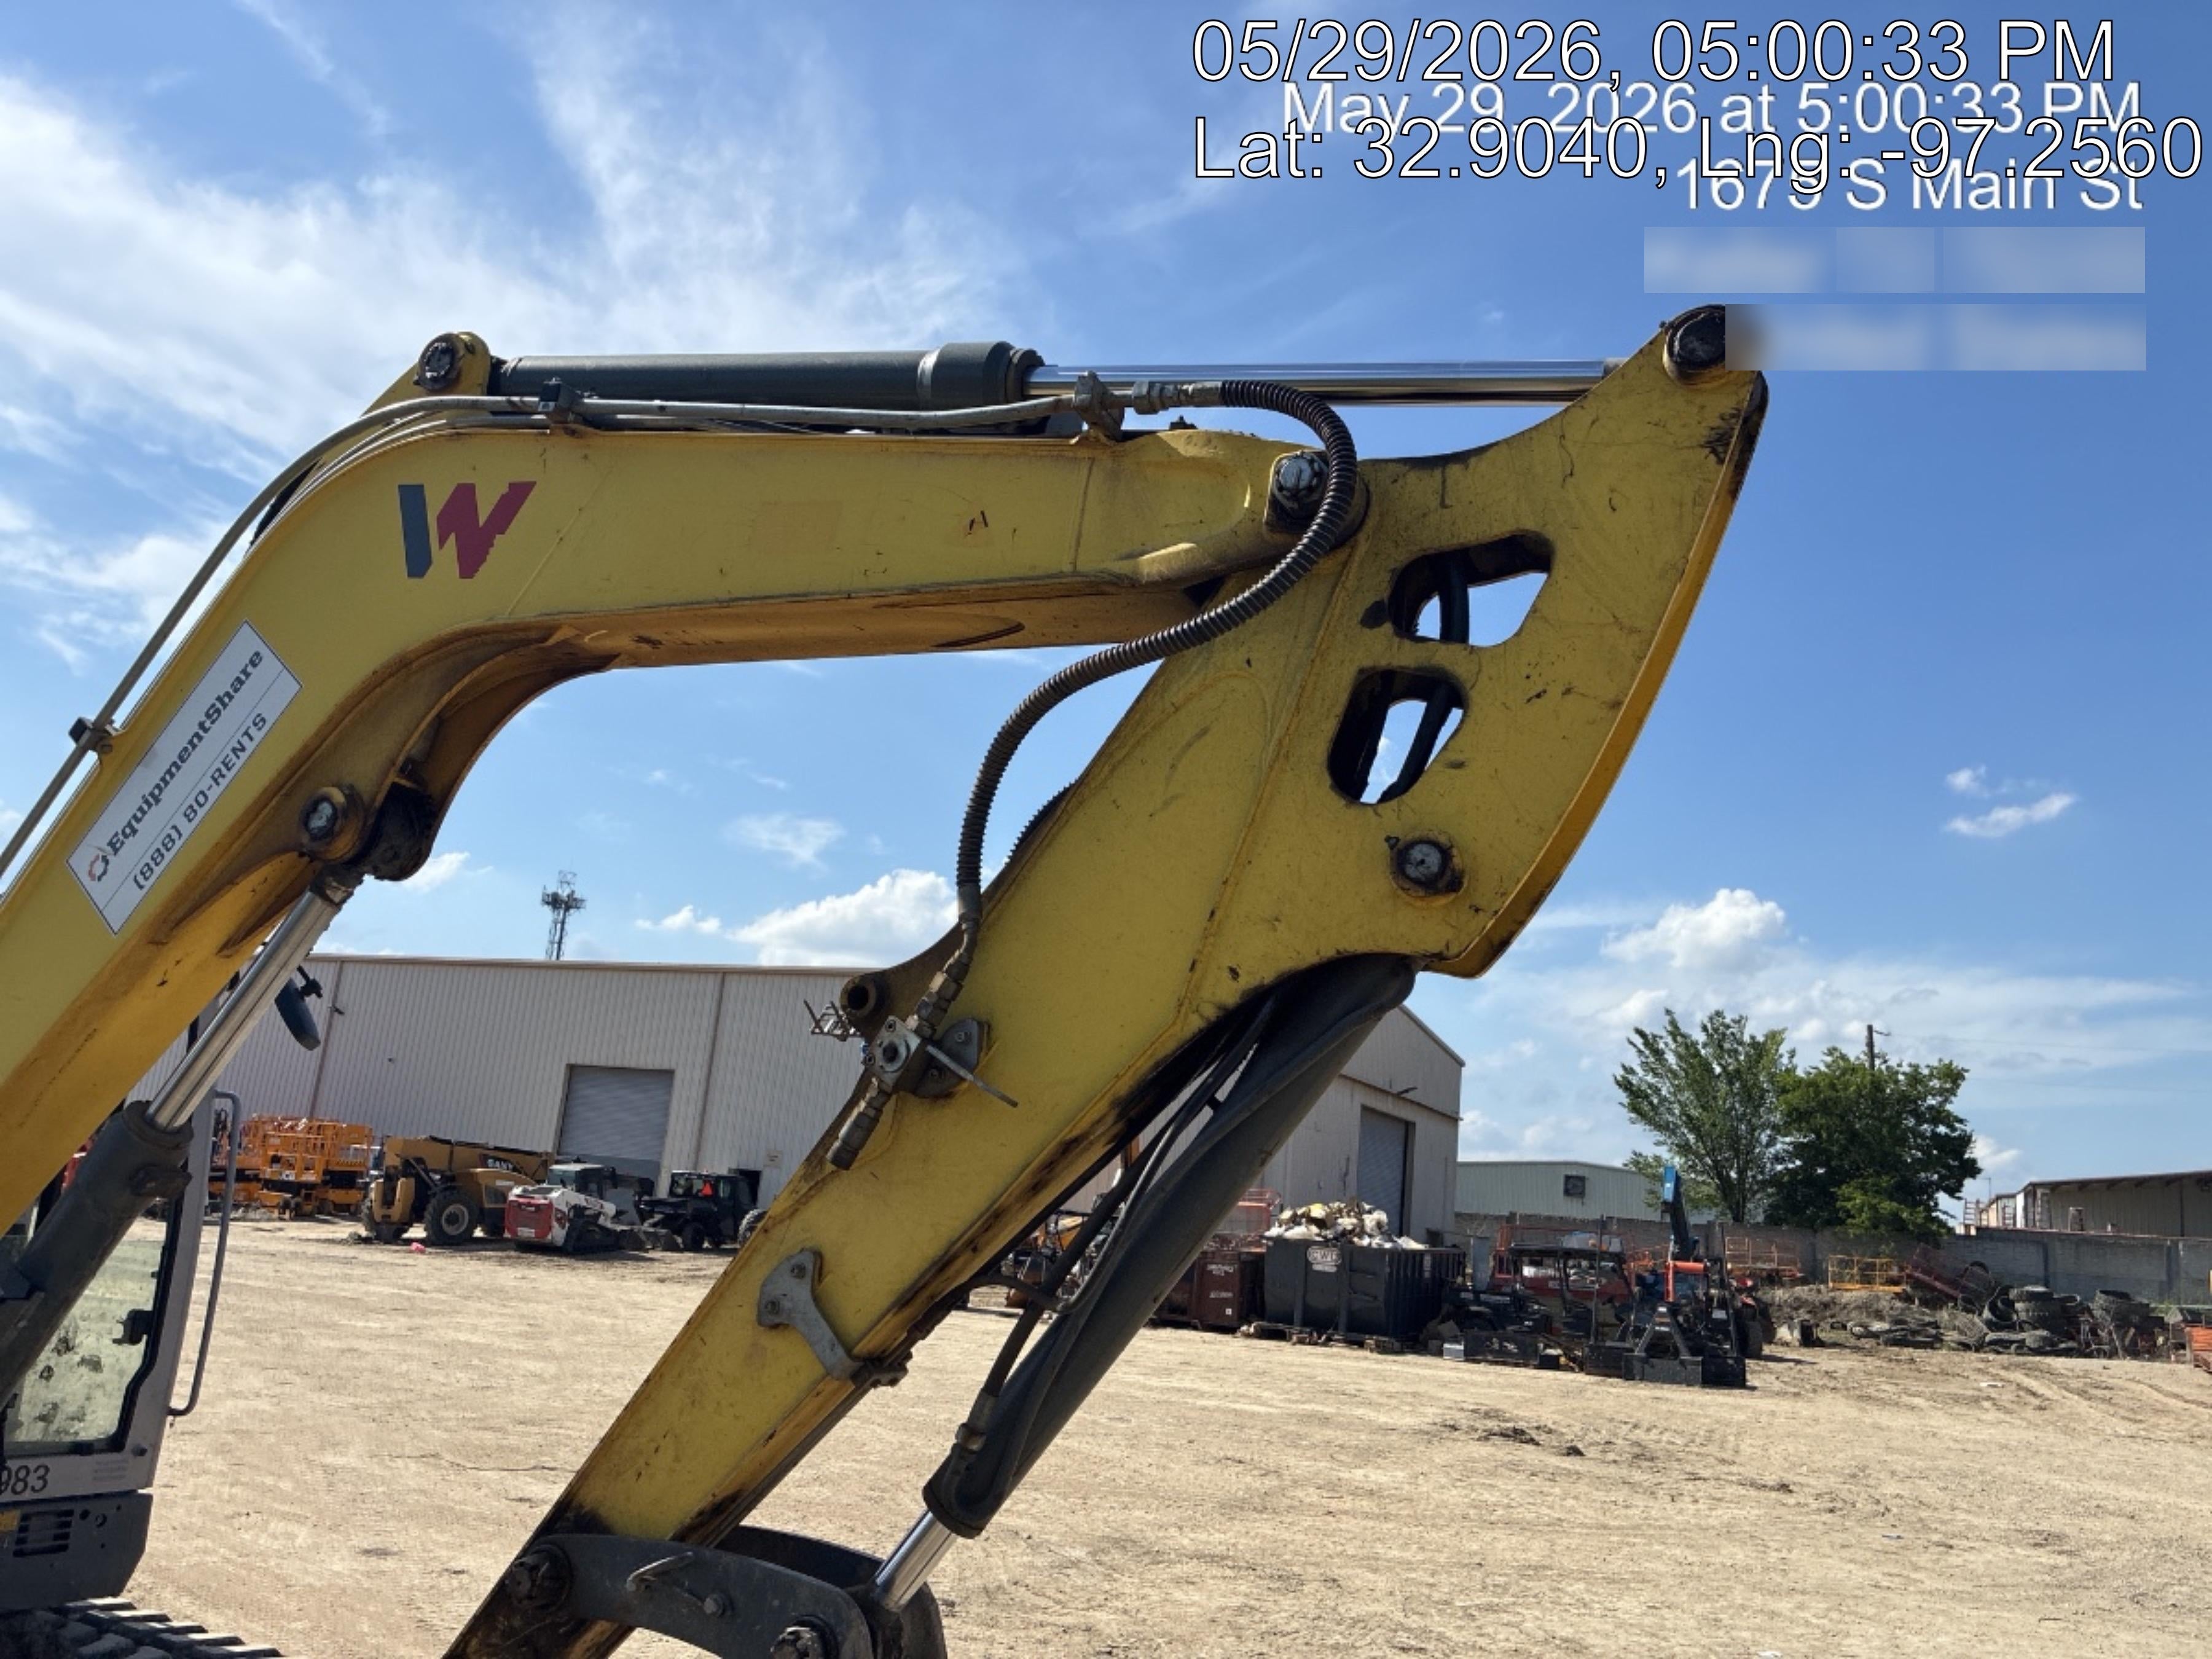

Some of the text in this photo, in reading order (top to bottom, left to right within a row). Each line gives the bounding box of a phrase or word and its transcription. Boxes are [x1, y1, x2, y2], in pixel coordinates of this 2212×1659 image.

[107, 649, 263, 857] EquipmentShare
[133, 712, 267, 891] (888) 80-RENTS
